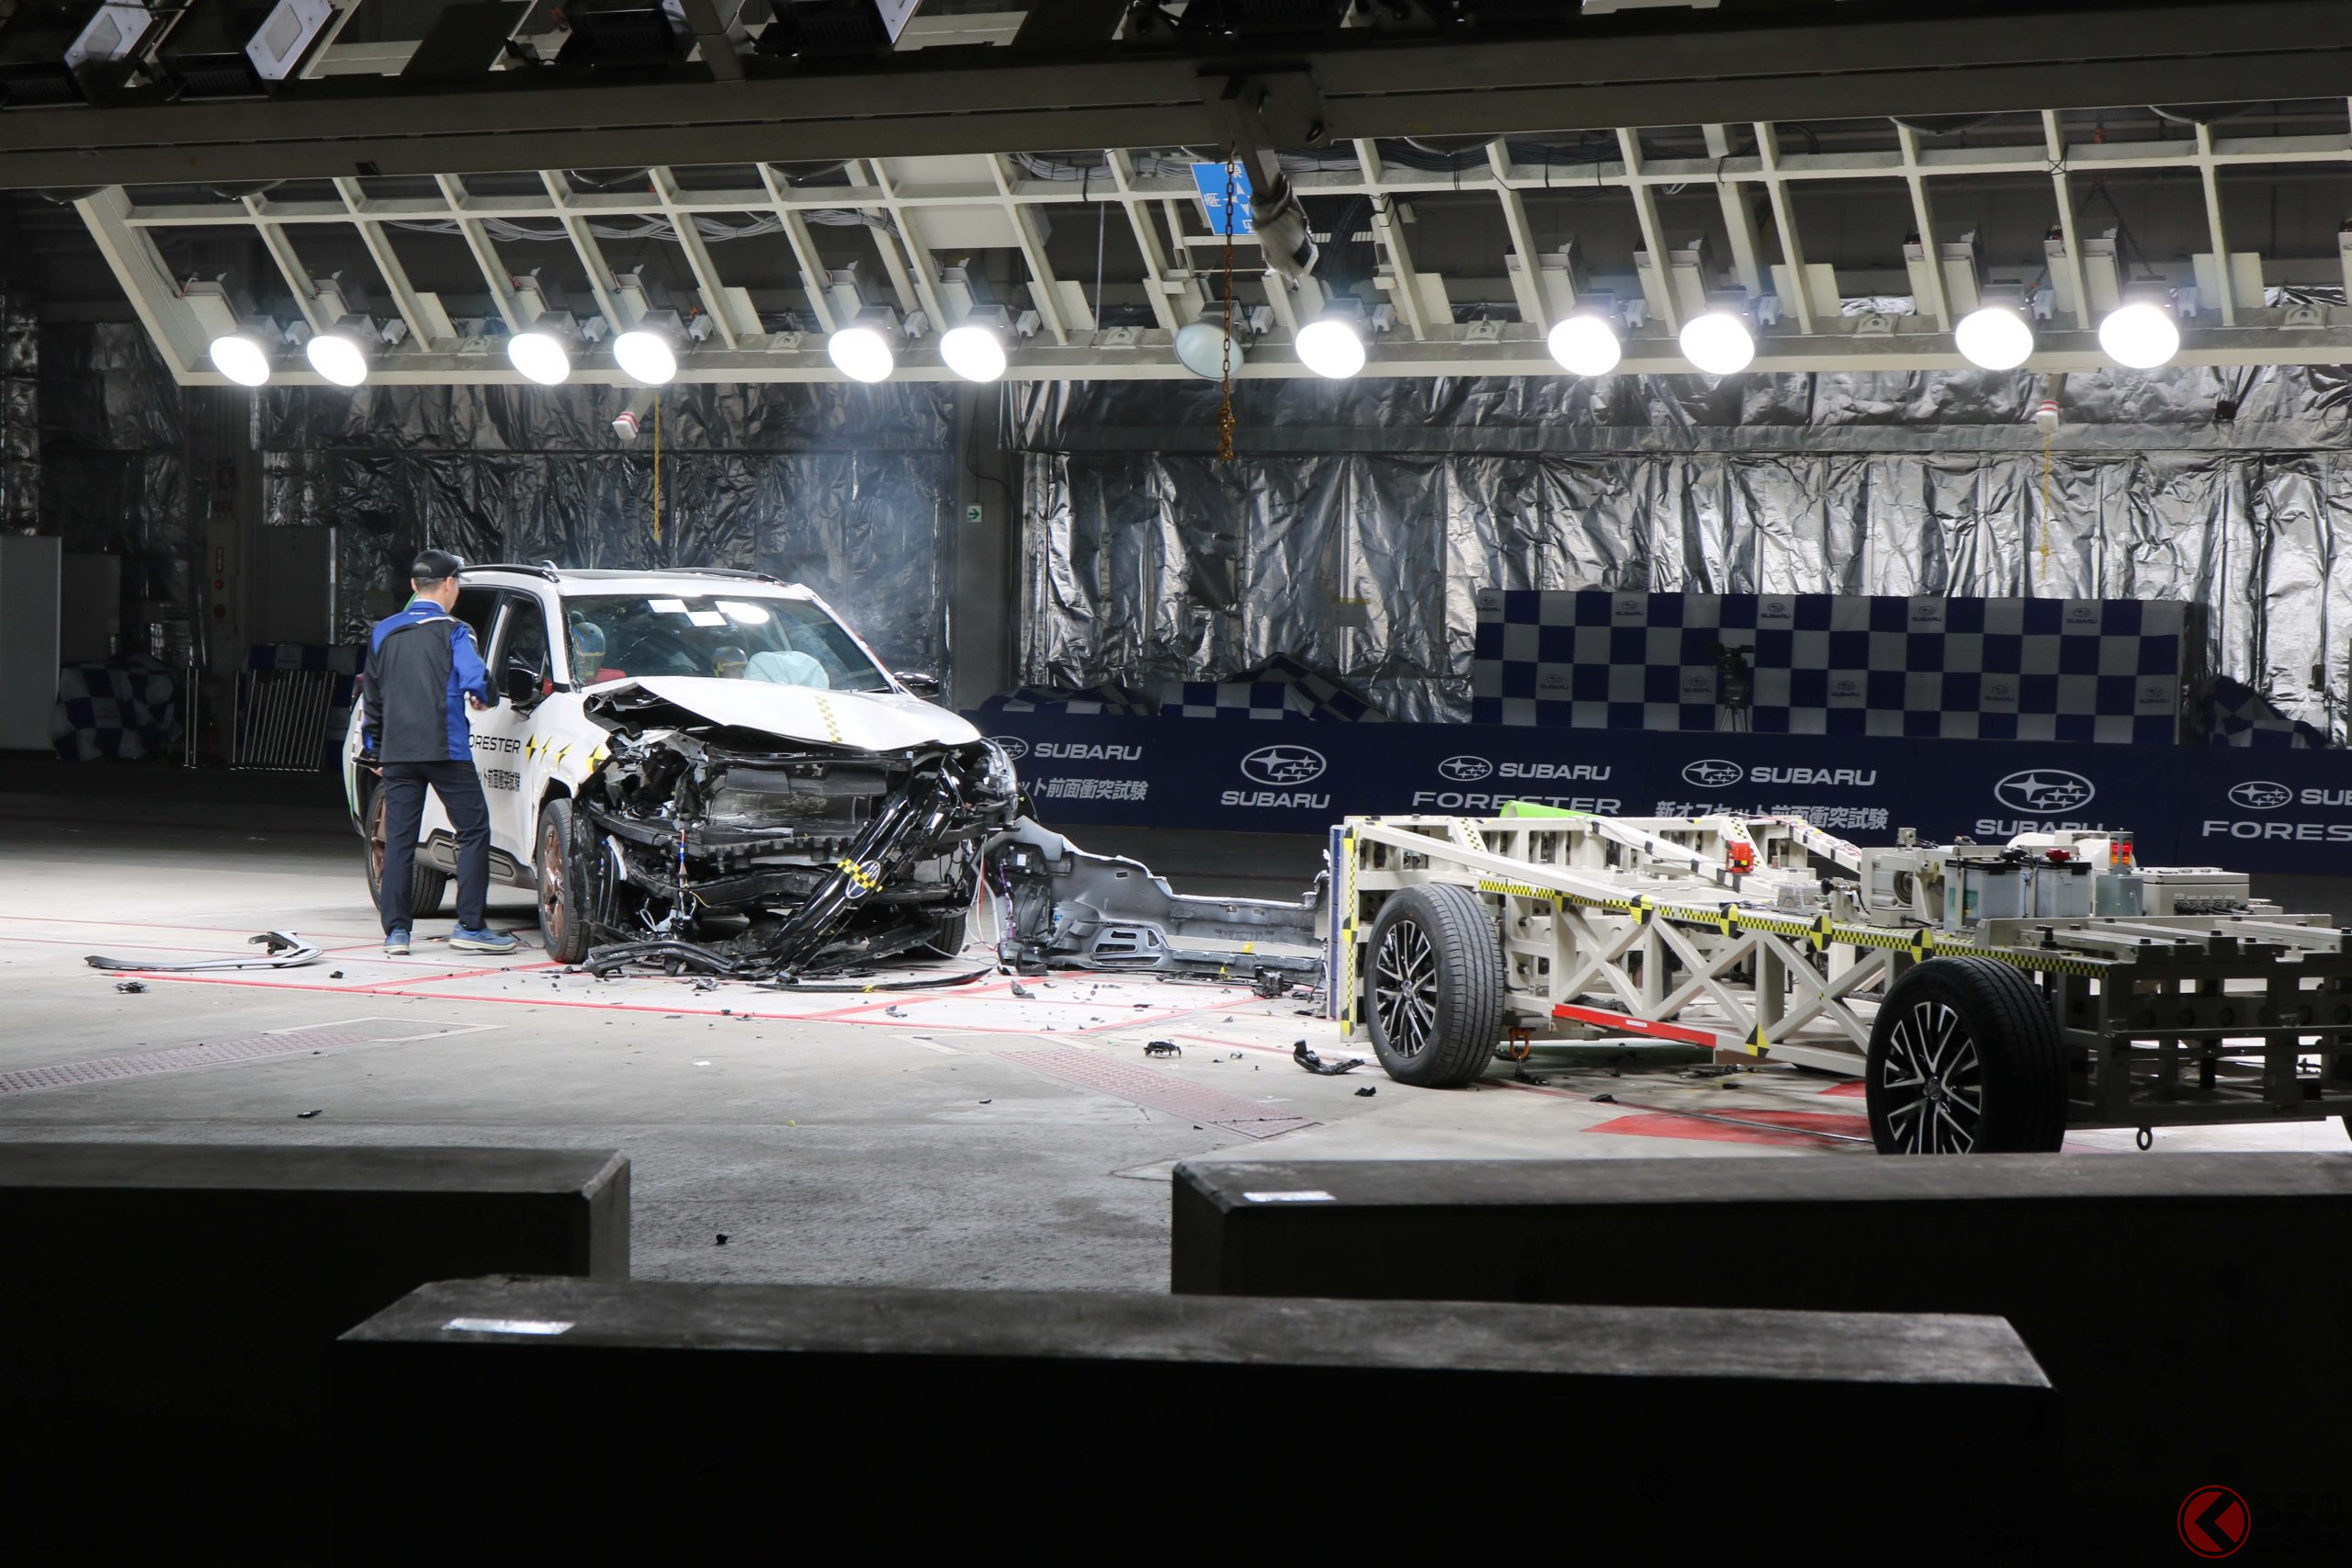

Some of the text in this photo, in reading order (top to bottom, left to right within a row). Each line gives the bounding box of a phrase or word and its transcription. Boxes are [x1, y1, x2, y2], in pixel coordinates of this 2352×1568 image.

[1034, 742, 1143, 761] SUBARU
[1499, 762, 1611, 781] SUBARU
[1749, 767, 1877, 786] SUBARU
[1220, 790, 1330, 809] SUBARU
[2202, 820, 2352, 841] FORES
